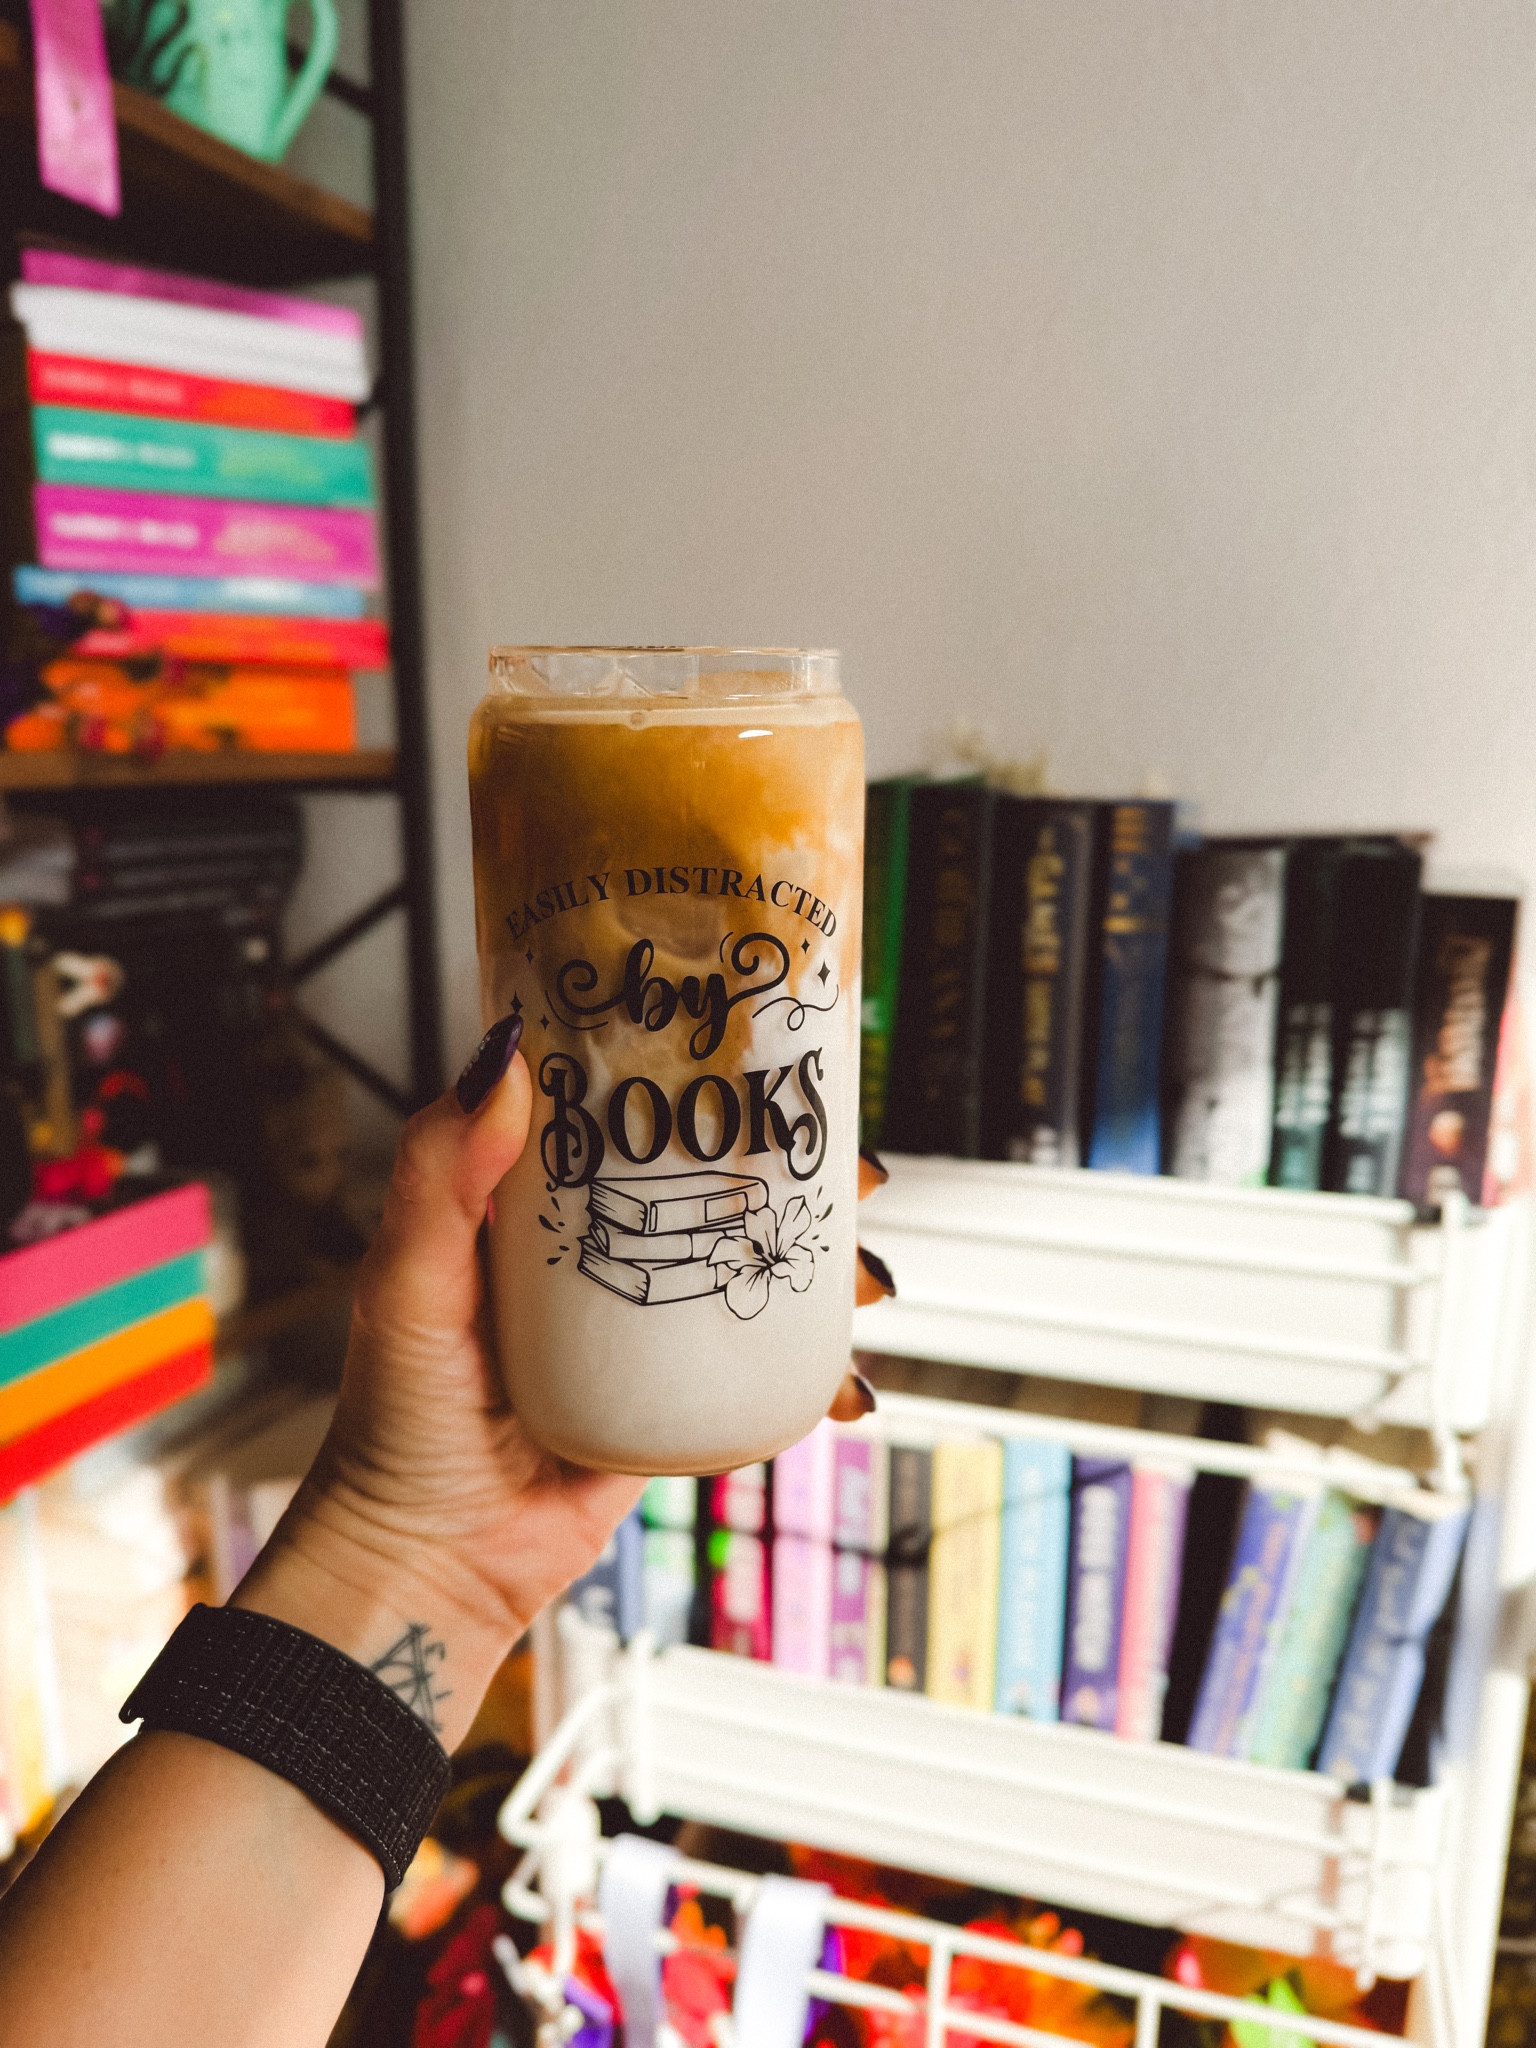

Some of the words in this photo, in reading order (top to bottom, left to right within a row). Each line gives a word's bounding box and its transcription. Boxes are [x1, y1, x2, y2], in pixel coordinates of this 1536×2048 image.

[506, 874, 610, 940] EASILY
[626, 867, 837, 938] DISTRACTED
[557, 933, 790, 1060] by
[540, 1048, 828, 1190] BOOKS
